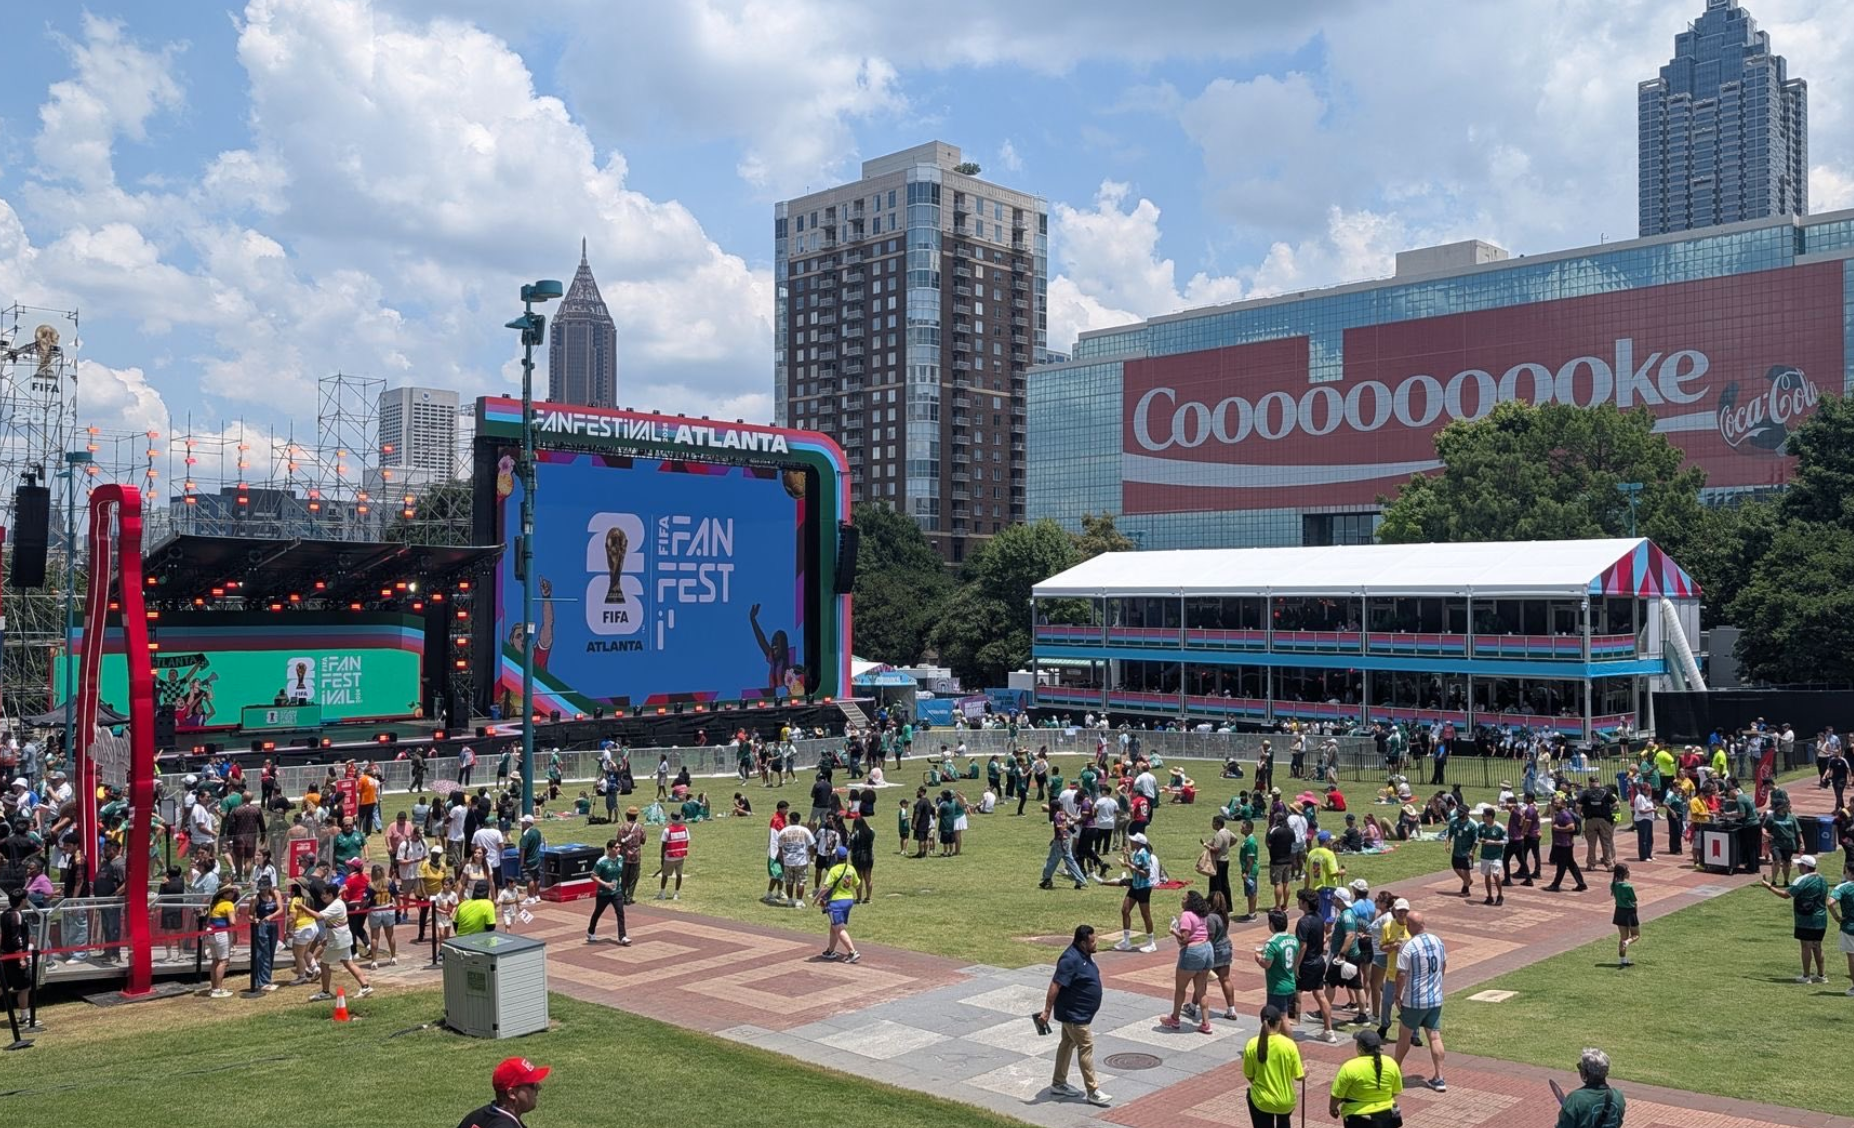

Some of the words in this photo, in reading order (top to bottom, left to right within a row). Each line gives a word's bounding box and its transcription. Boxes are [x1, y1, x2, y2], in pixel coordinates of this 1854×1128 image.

[32, 382, 60, 393] FIFA
[1719, 367, 1819, 447] Coca-Cola
[674, 424, 788, 454] ATLANTA
[658, 515, 670, 555] FIFA
[671, 515, 733, 557] FAN
[657, 562, 735, 603] FEST
[603, 610, 629, 623] FIFA
[586, 640, 644, 652] ATLANTA
[328, 656, 362, 671] FAN
[321, 672, 362, 688] FEST
[1426, 955, 1438, 975] 10
